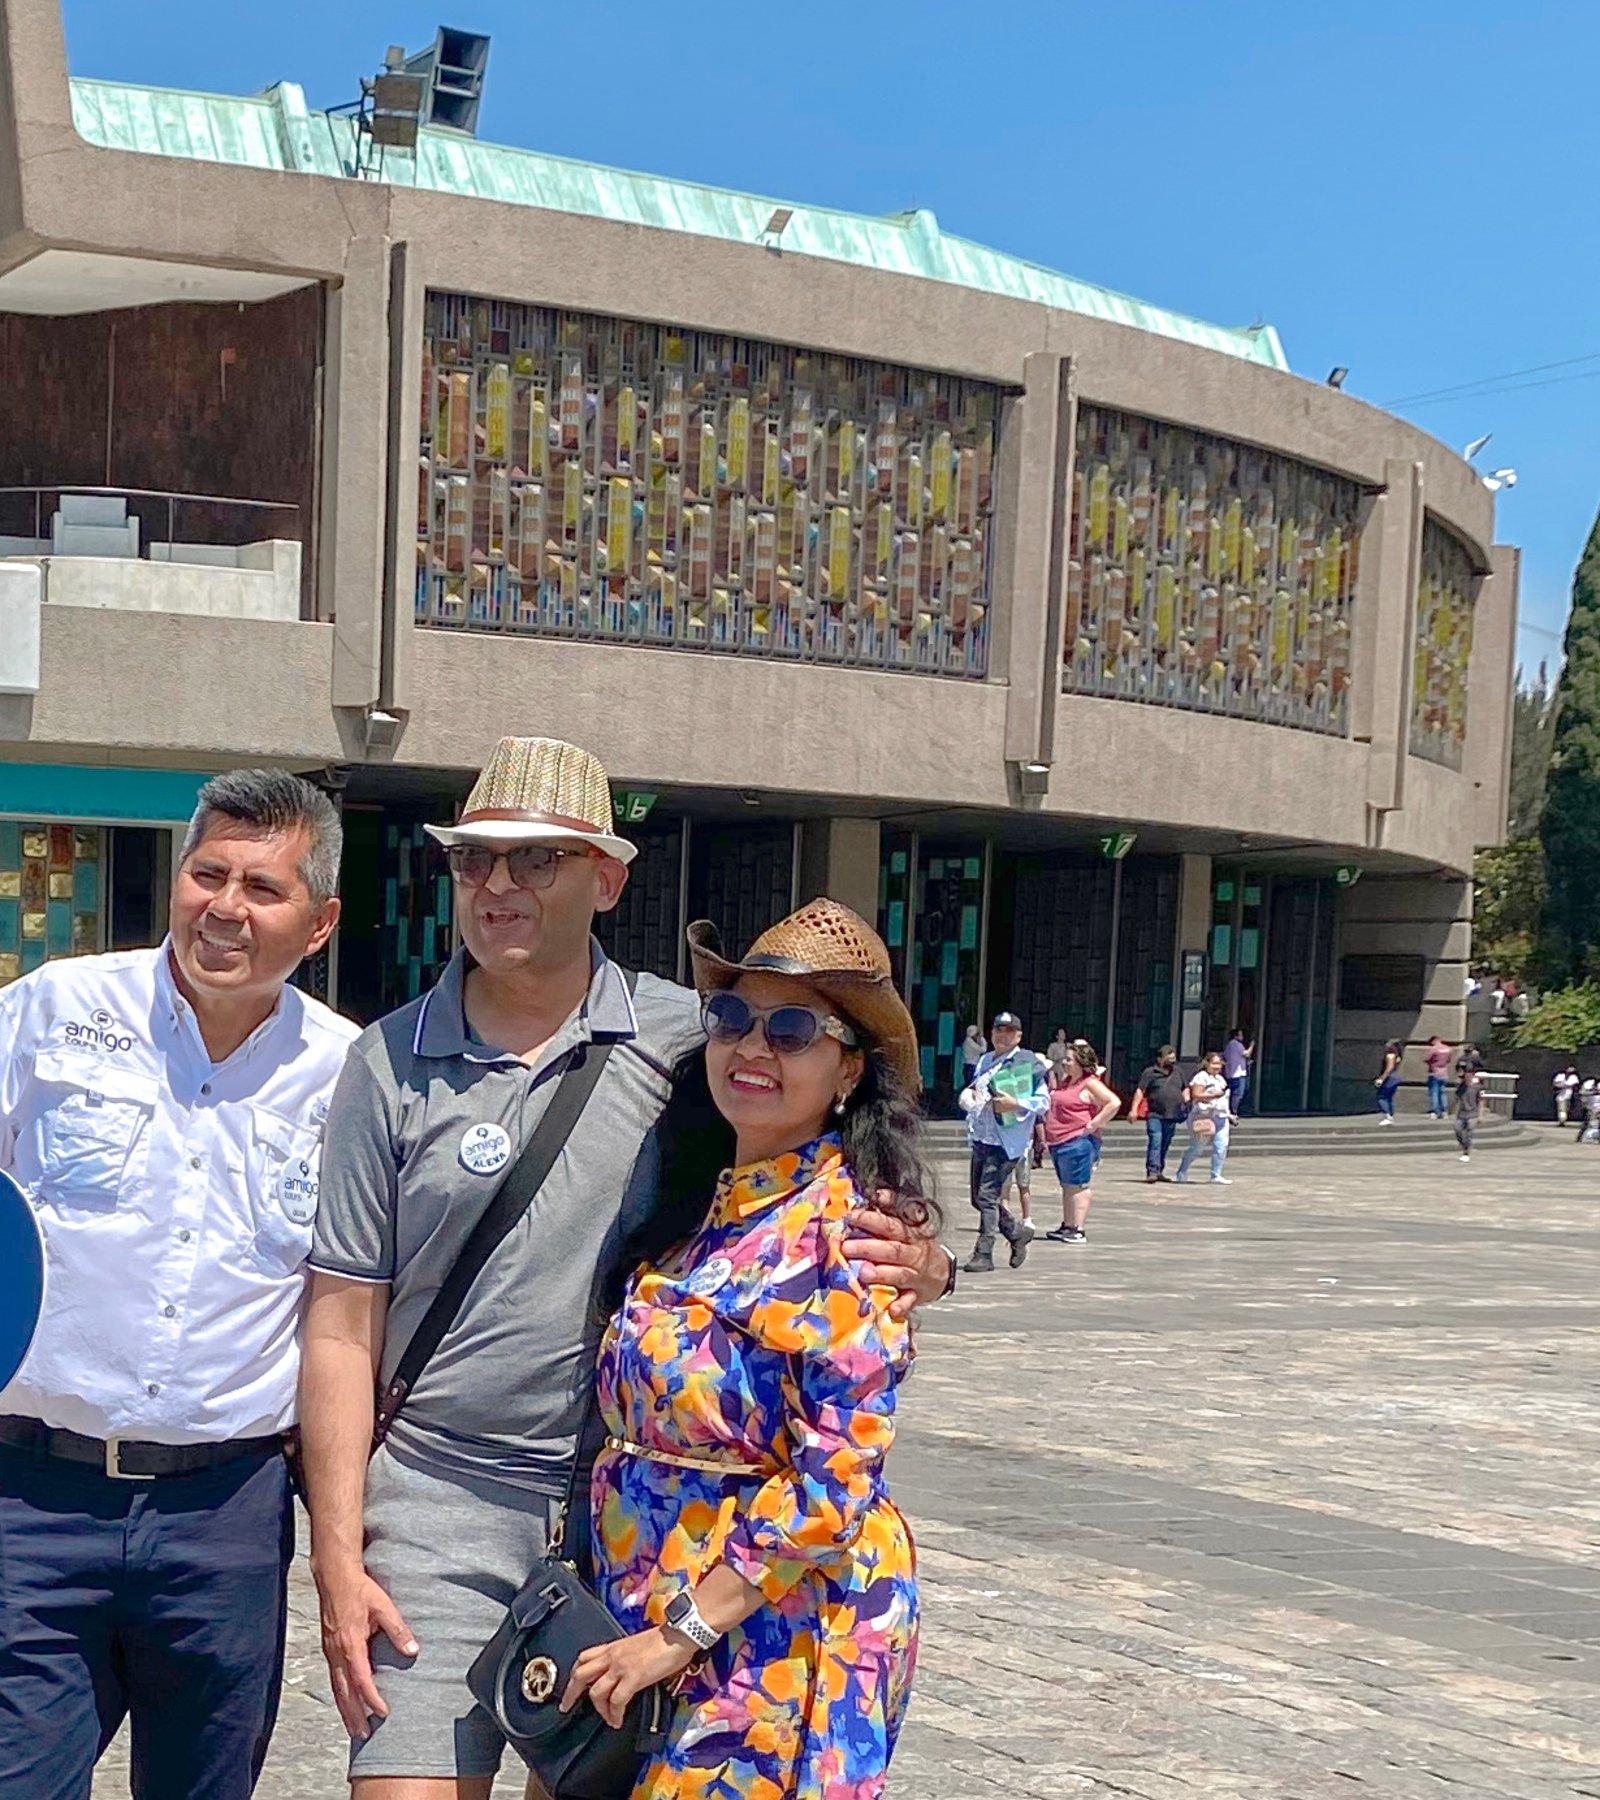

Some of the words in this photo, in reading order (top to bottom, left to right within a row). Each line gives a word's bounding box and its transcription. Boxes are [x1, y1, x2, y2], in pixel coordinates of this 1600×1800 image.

[1100, 837, 1112, 853] 7
[64, 1020, 133, 1053] amigo
[64, 1035, 98, 1052] tours
[465, 1136, 505, 1156] amigo
[473, 1152, 506, 1167] ALEXA
[284, 1176, 320, 1199] amigo
